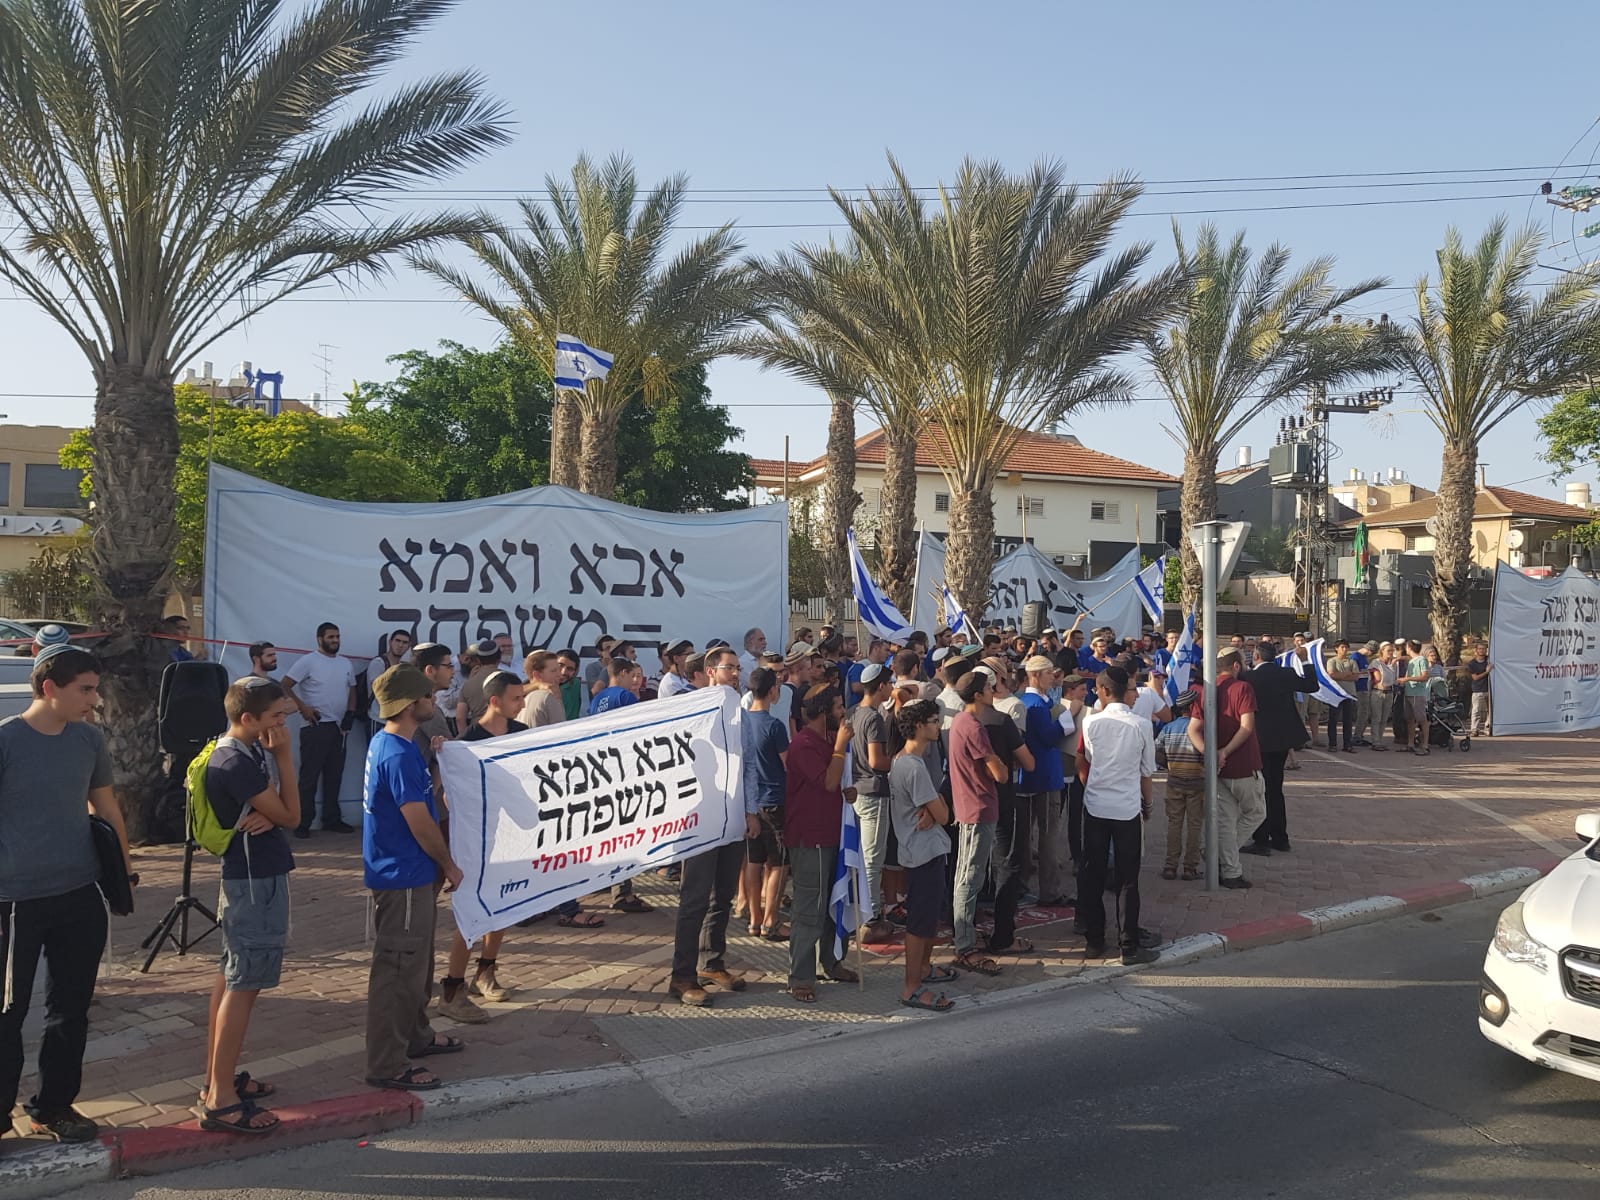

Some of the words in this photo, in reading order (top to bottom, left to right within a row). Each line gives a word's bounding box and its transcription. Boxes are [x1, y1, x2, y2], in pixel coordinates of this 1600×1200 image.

[379, 538, 541, 594] ואמא
[569, 543, 685, 598] אבא
[533, 746, 625, 803] ואמא
[632, 731, 696, 776] אבא
[536, 780, 667, 849] משפחה
[651, 812, 699, 844] האומץ
[531, 845, 593, 874] נורמלי
[598, 826, 646, 858] להיות
